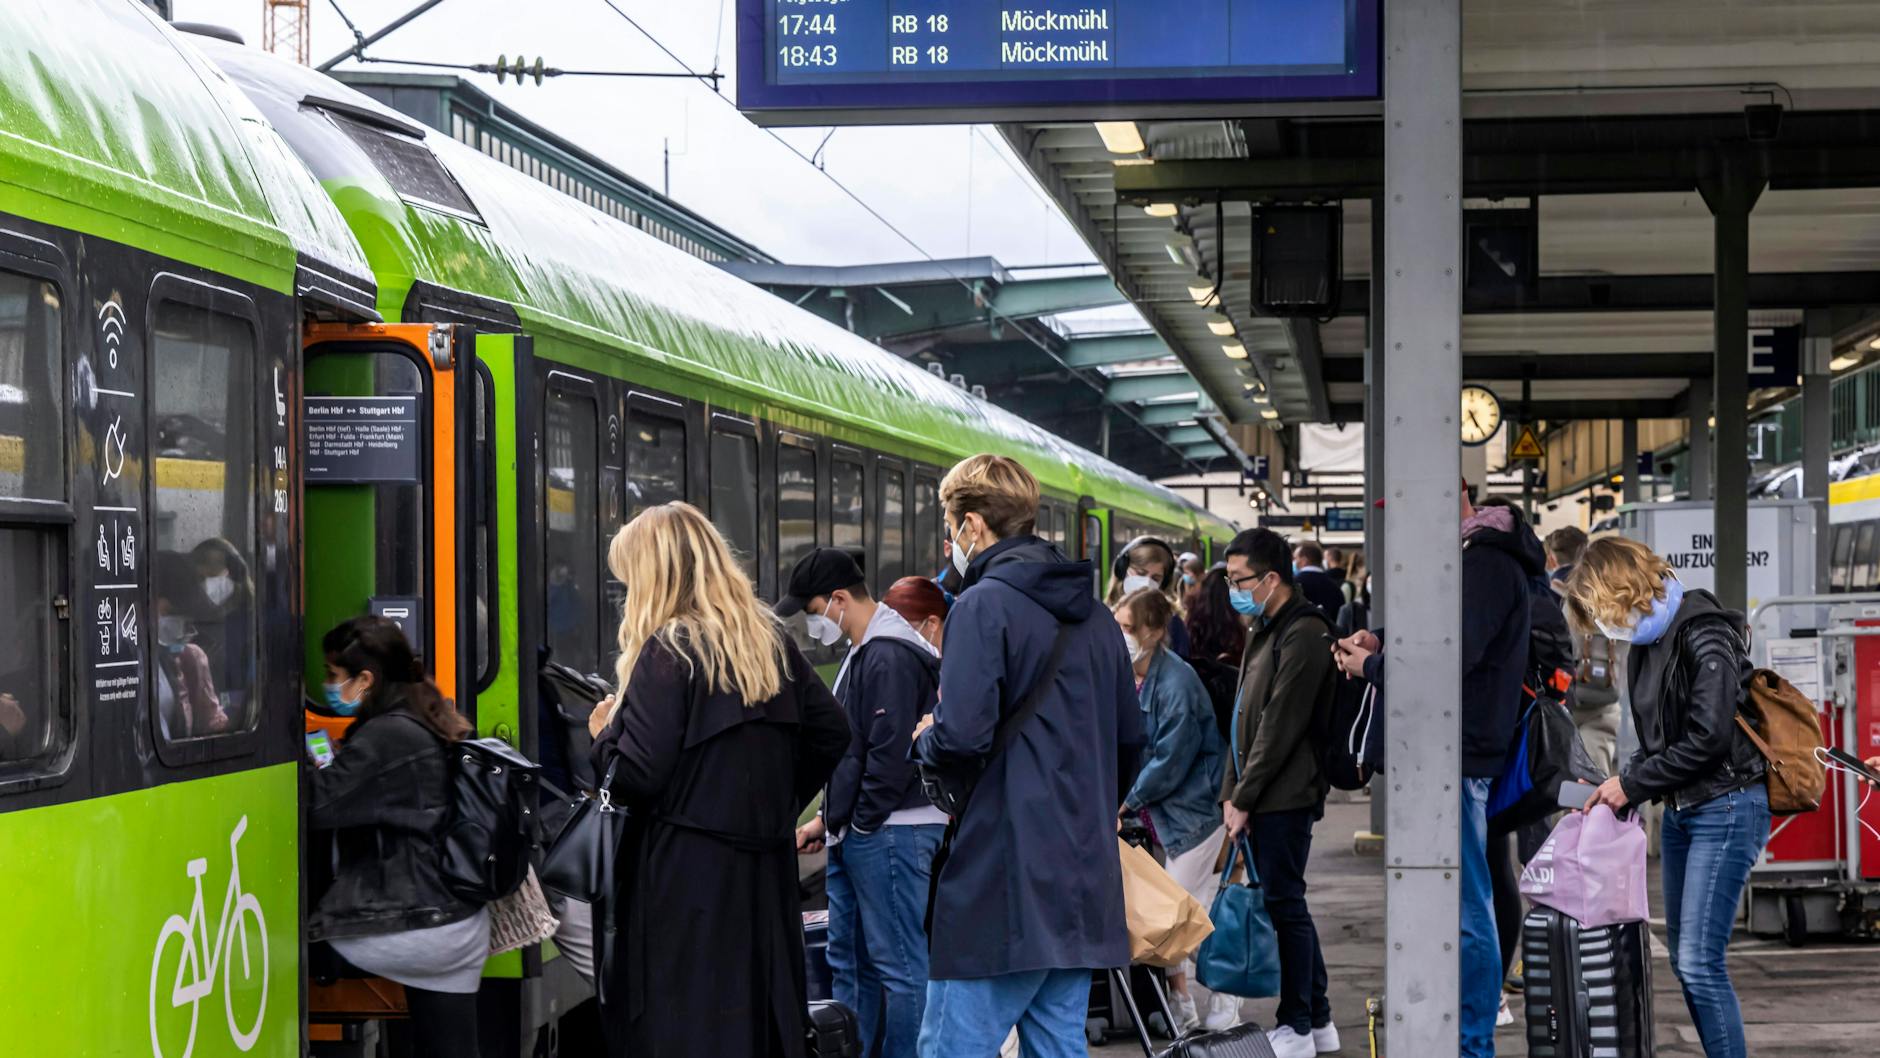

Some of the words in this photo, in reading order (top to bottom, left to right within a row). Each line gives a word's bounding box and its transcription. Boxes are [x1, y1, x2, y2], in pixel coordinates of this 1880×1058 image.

[779, 14, 837, 35] 17:44
[892, 15, 918, 33] RB
[926, 14, 948, 33] 18
[1001, 9, 1109, 31] Möckmühl
[779, 45, 838, 66] 18:43
[892, 46, 918, 65] RB
[926, 46, 949, 65] 18
[1001, 40, 1109, 63] Möckmühl
[1747, 328, 1775, 374] E
[309, 406, 329, 414] Berlin
[331, 406, 343, 414] Hbf
[359, 406, 391, 416] Stuttgart
[392, 406, 405, 414] Hbf
[1520, 866, 1555, 884] ALDI
